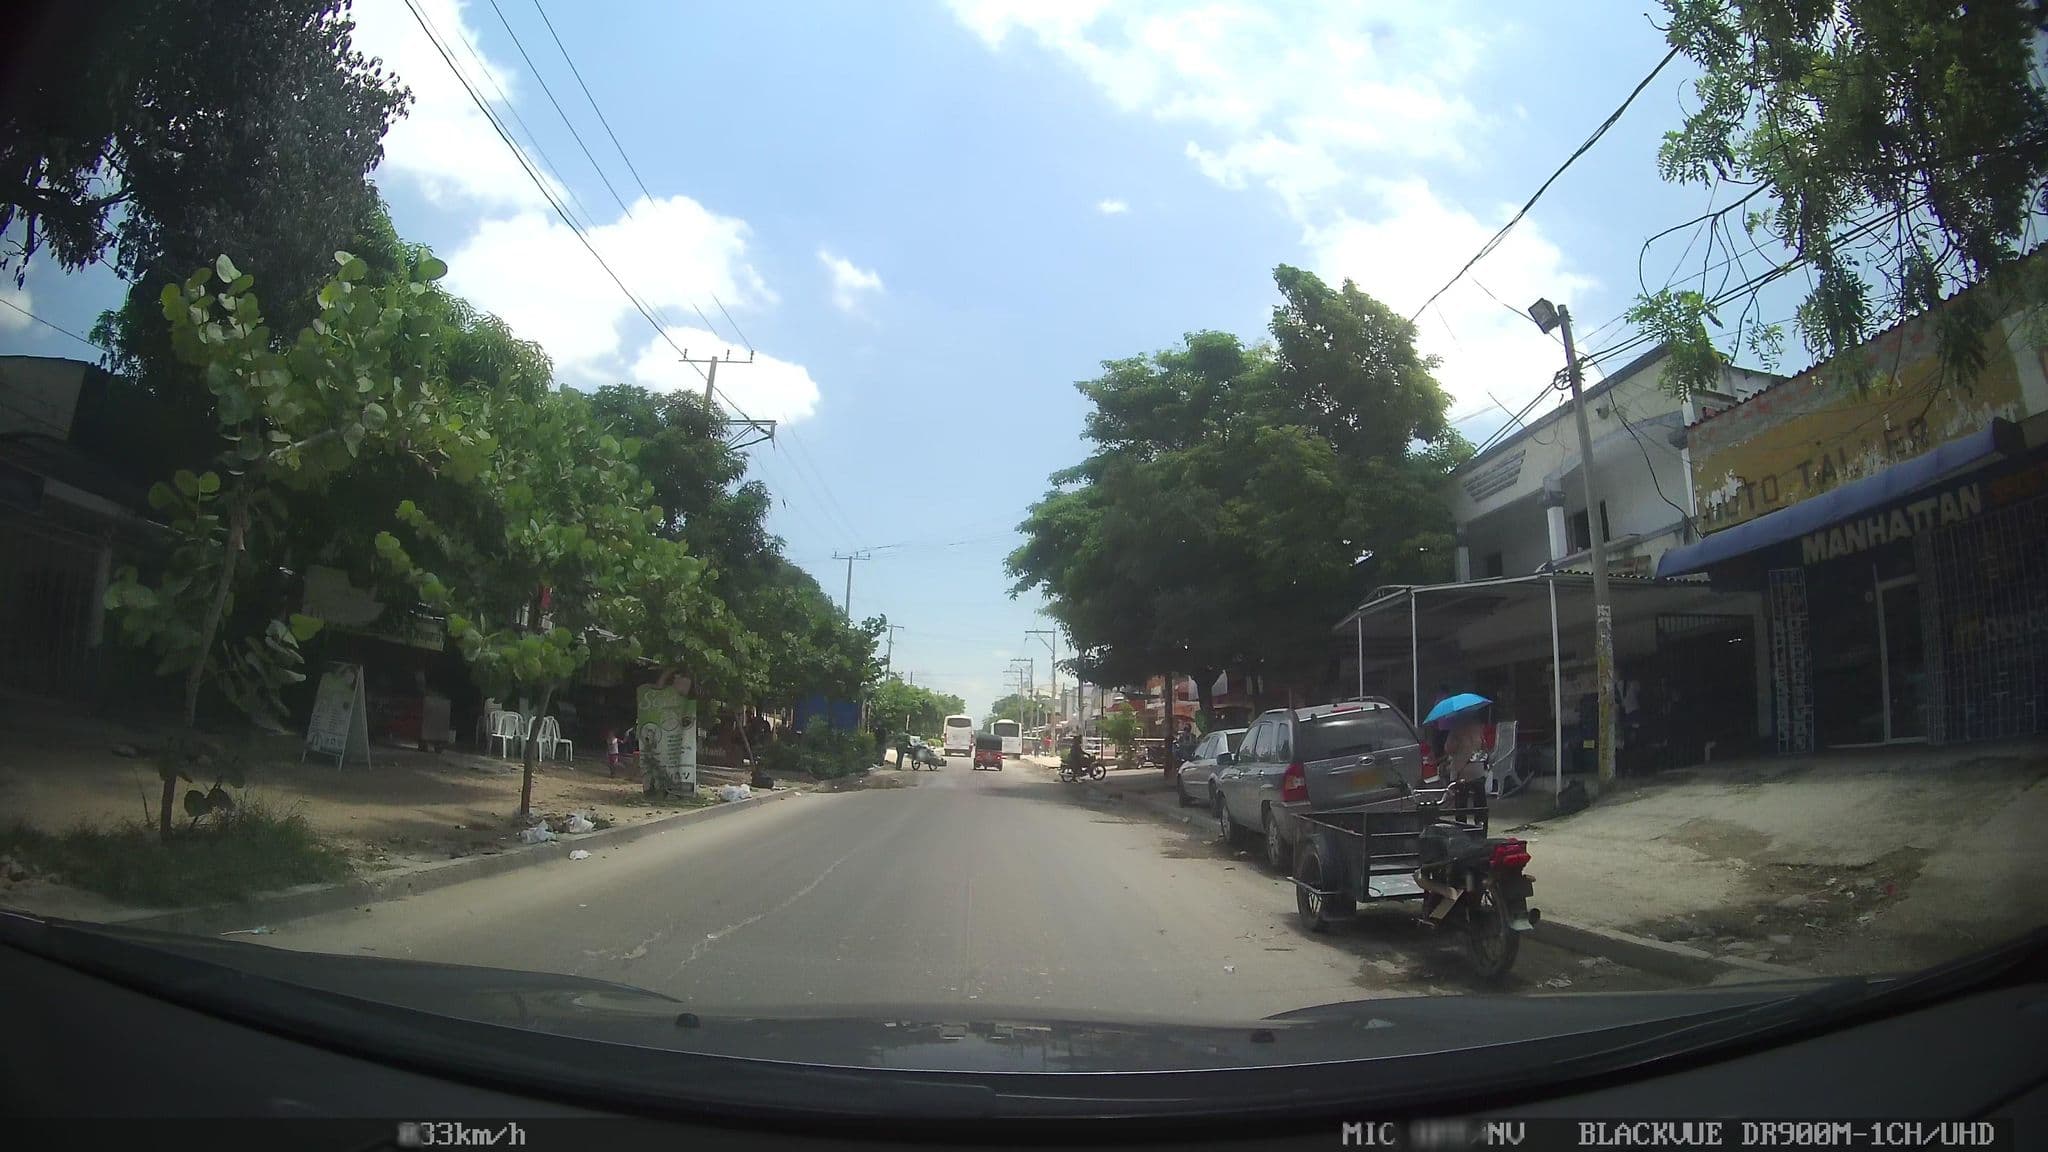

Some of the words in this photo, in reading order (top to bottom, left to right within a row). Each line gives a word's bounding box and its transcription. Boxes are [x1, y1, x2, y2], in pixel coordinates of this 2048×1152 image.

[1704, 474, 1779, 520] UTO
[1797, 416, 1928, 489] TALER
[1803, 483, 1982, 565] MANHATTAN
